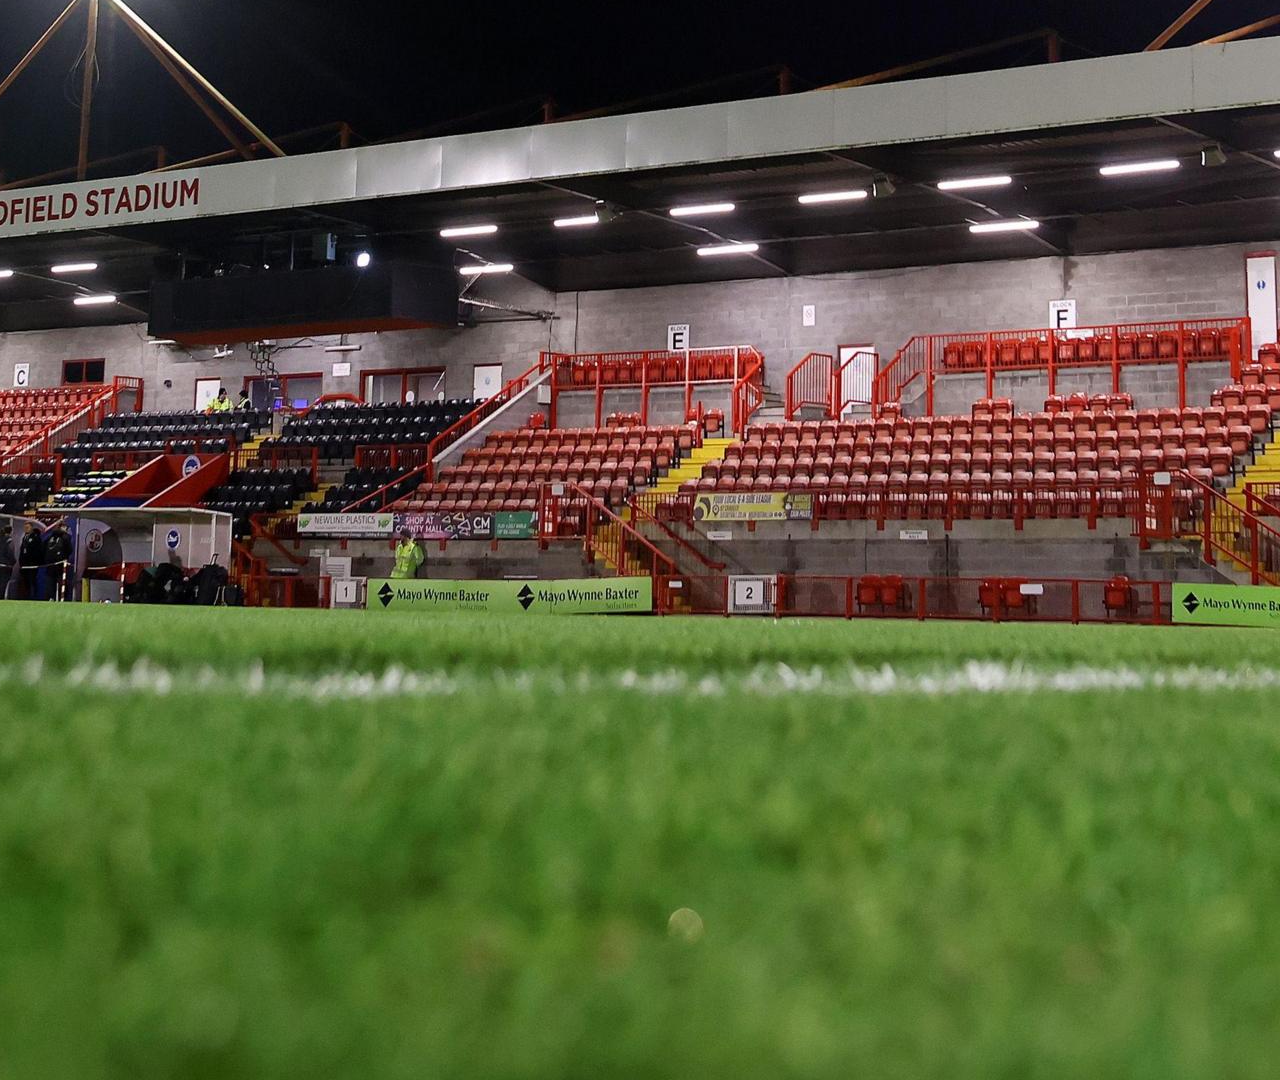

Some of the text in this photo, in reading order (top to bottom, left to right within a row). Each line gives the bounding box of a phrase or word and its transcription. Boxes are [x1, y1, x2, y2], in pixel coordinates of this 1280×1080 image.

[85, 177, 200, 217] STADIUM
[1057, 309, 1068, 329] F
[673, 332, 684, 350] E
[17, 370, 25, 385] C
[315, 515, 375, 525] NEWLINE PLASTICS
[406, 516, 434, 525] SHOP AT
[473, 517, 490, 529] CM
[425, 525, 443, 533] MALL
[397, 589, 490, 604] Mayo Wynne Baxter
[538, 588, 639, 605] Mayo Wynne Baxter
[746, 587, 753, 599] 2
[1203, 597, 1230, 611] Mayo
[1232, 599, 1266, 612] Wynne
